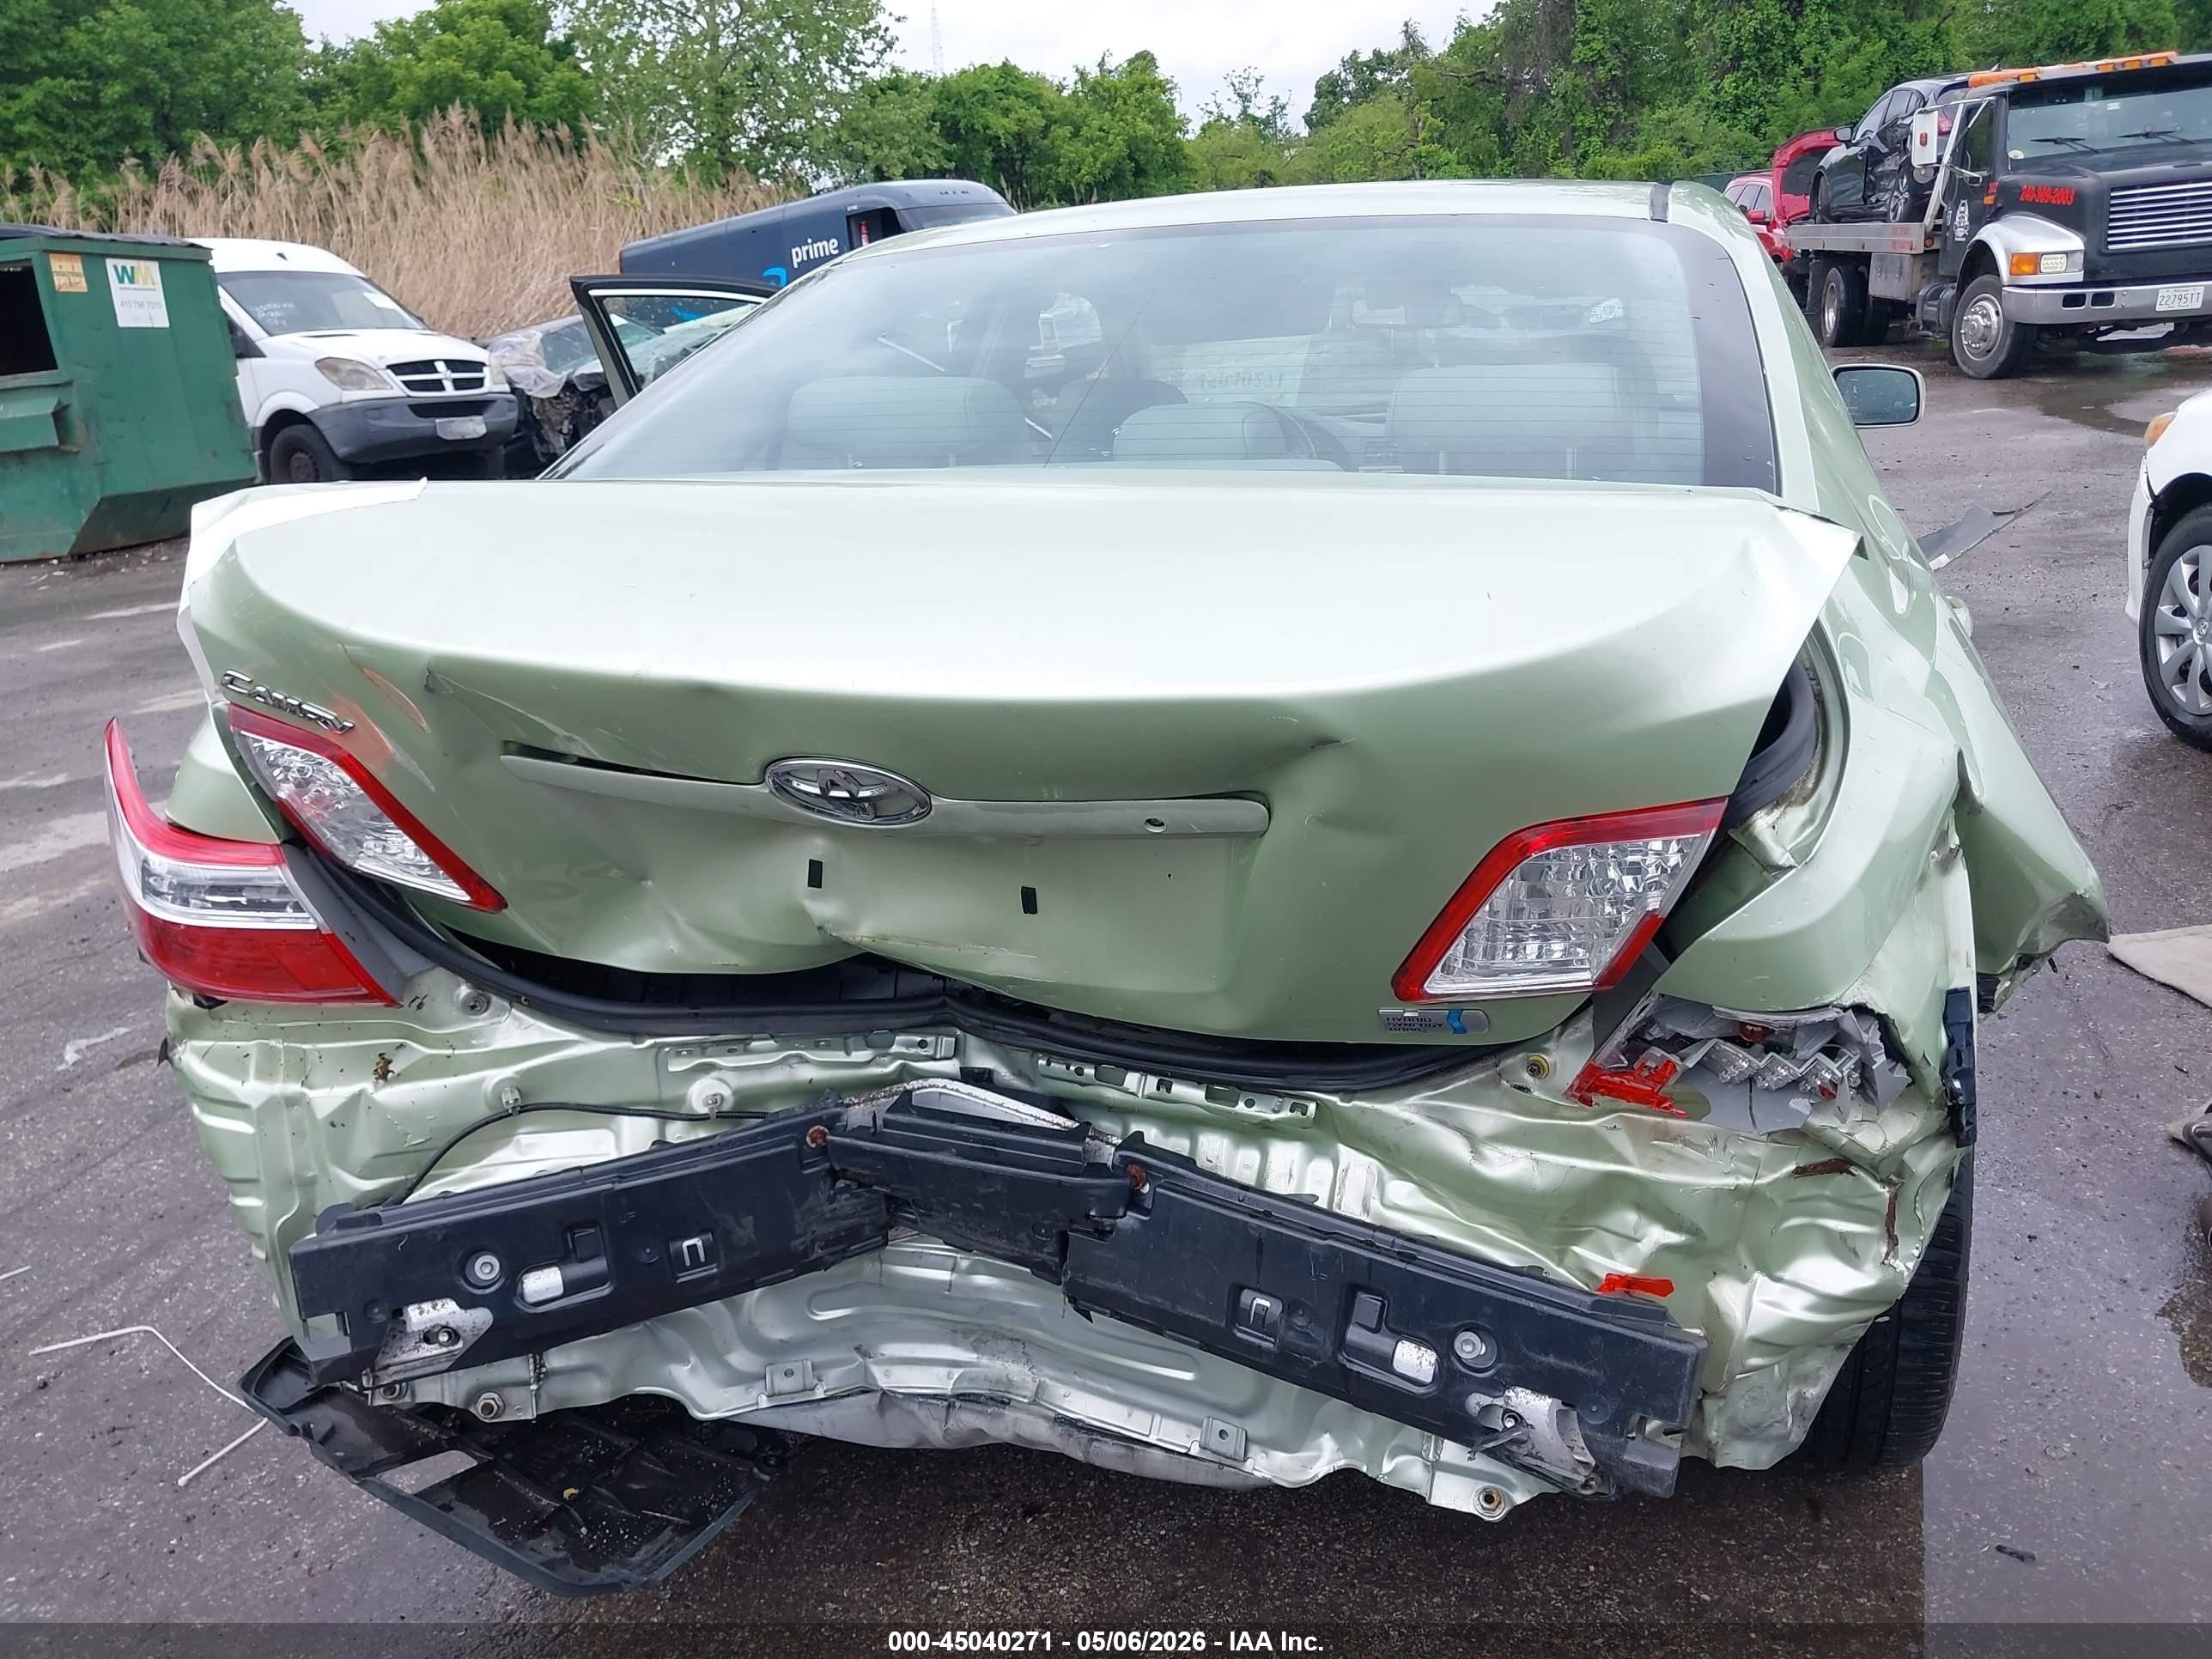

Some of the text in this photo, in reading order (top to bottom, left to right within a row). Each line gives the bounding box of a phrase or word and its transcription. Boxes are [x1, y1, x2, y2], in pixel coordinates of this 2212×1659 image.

[791, 237, 839, 268] prime
[112, 264, 156, 285] WM
[2159, 293, 2202, 306] 22795TT
